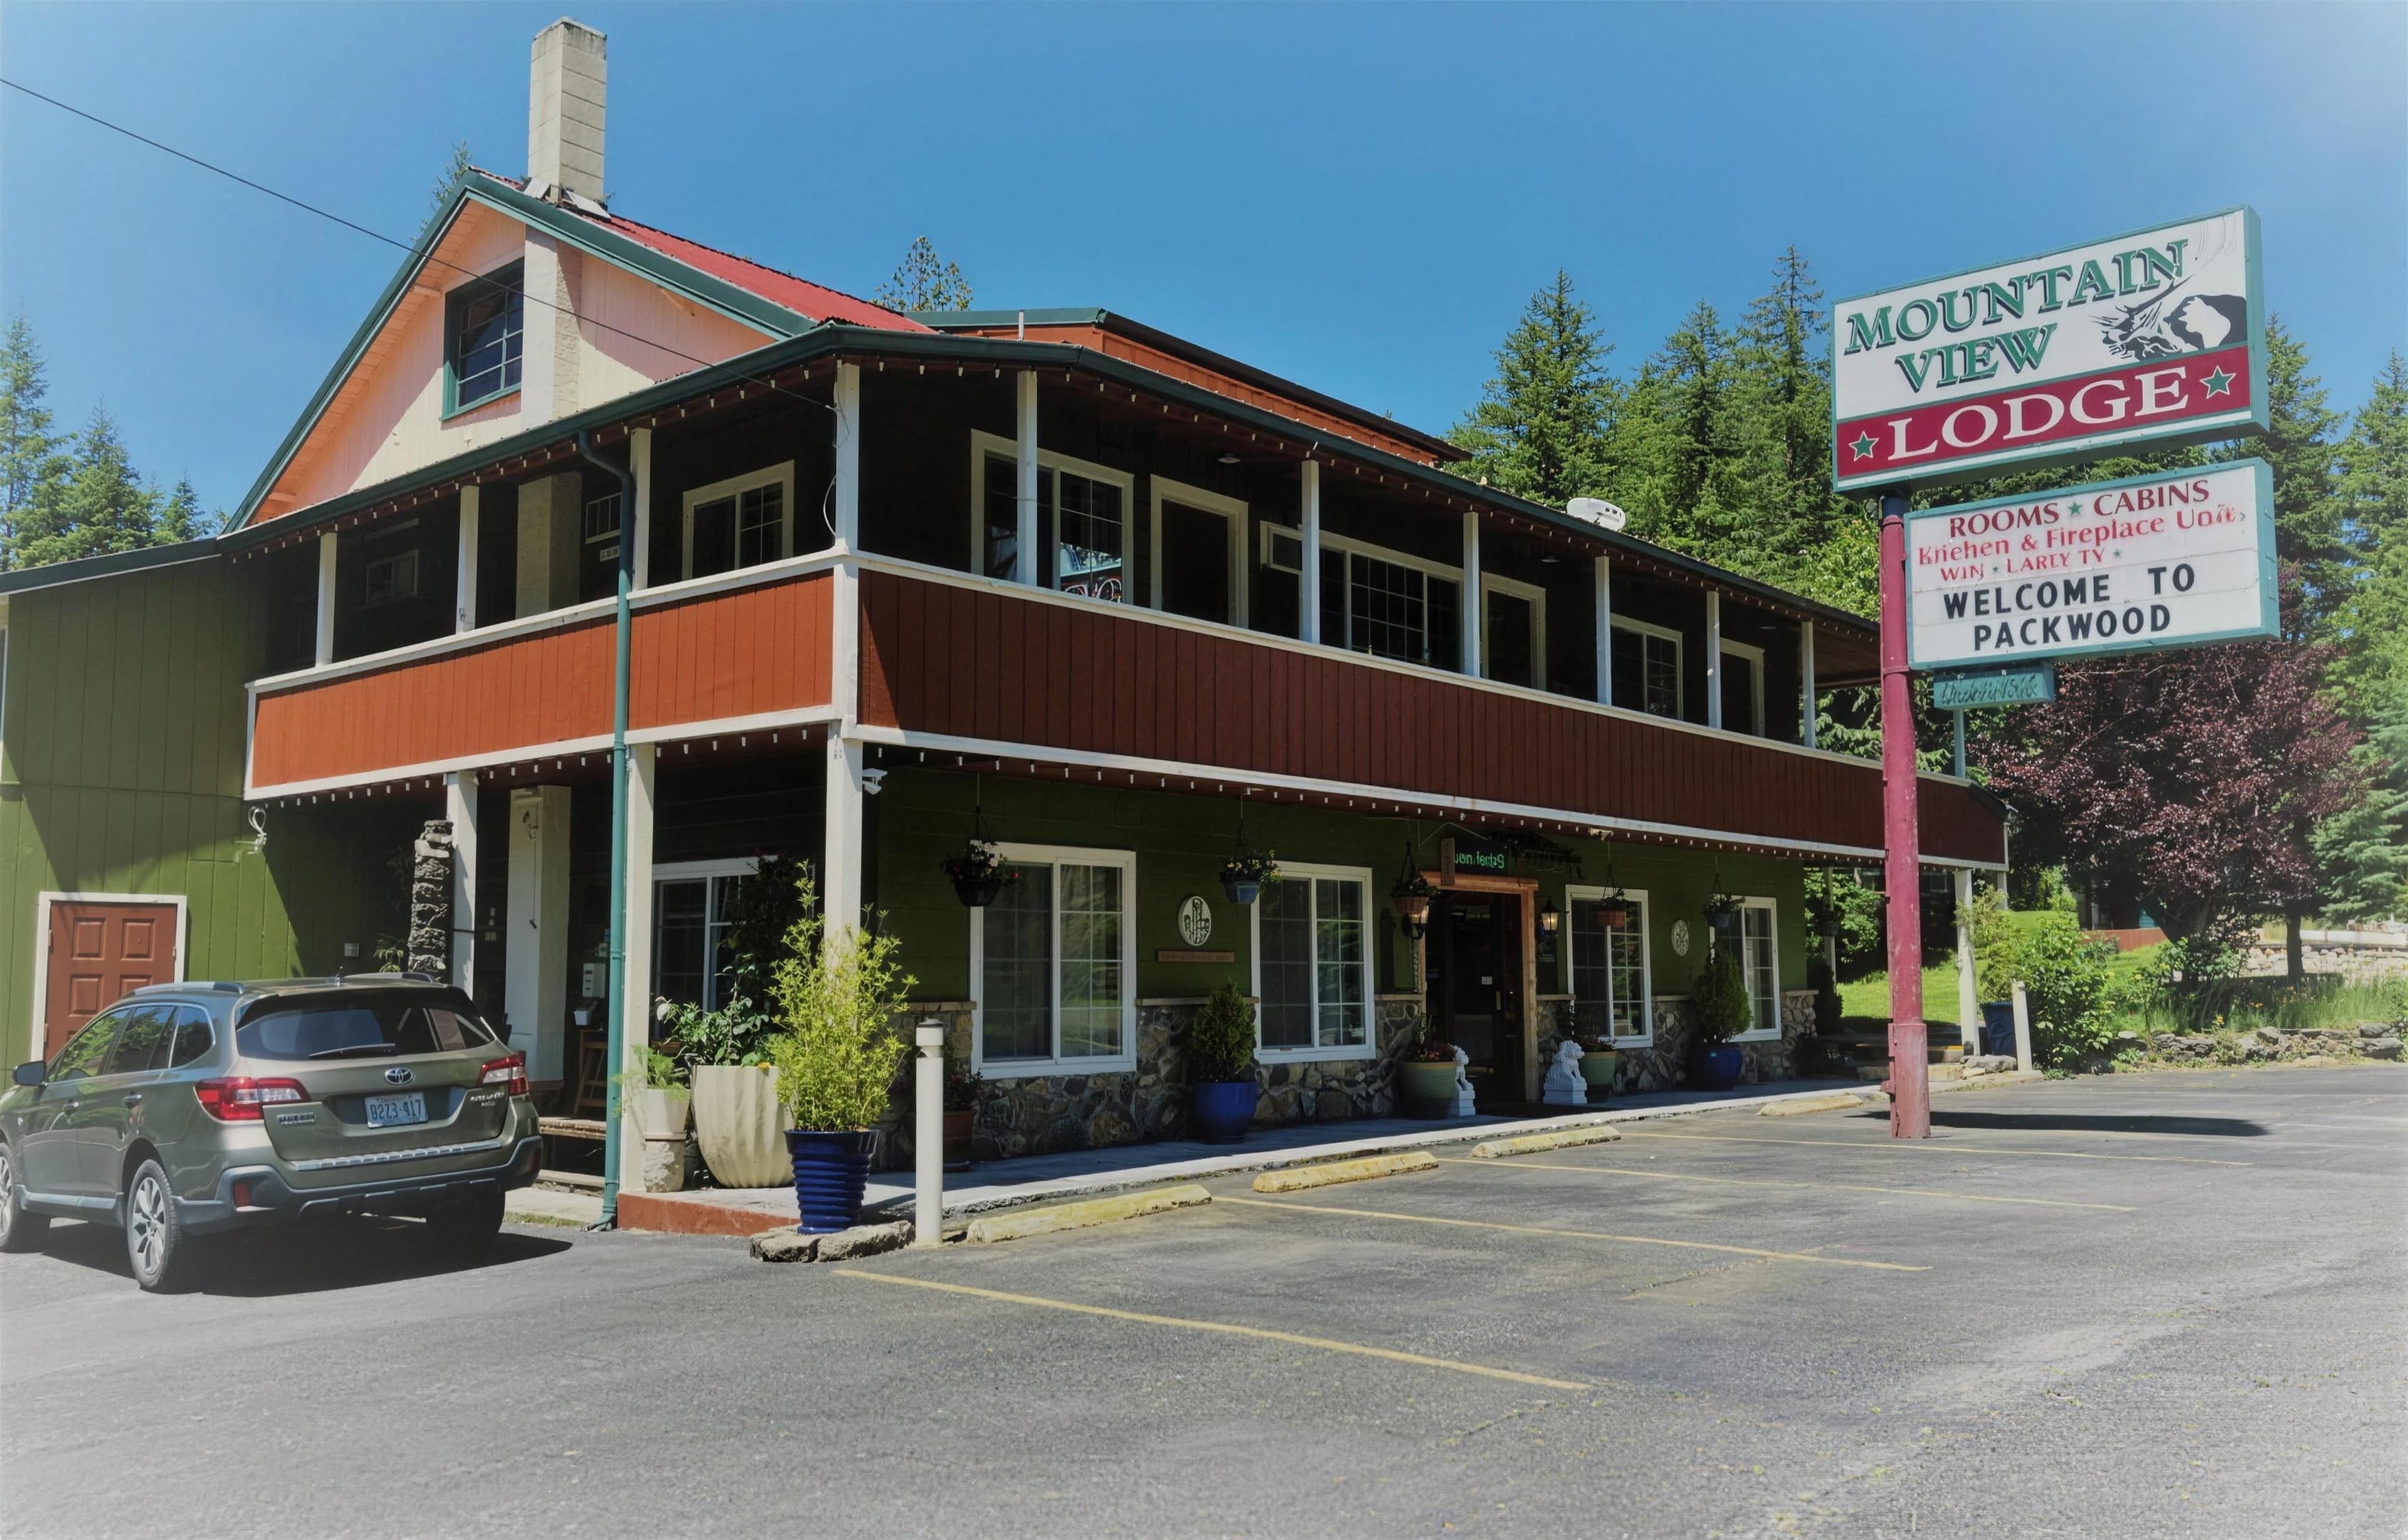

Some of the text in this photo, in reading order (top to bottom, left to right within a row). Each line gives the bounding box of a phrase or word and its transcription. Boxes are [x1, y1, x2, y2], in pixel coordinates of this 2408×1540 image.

[1844, 238, 2188, 355] MOUNTAIN
[1894, 322, 2058, 393] VIEW
[1887, 366, 2189, 460] LODGE
[1950, 480, 2210, 538] ROOMS CABINS
[2020, 534, 2038, 552] &
[2047, 516, 2165, 549] Fireplace
[1943, 563, 2195, 620] WELCOME TO
[1973, 604, 2171, 651] PACKWOOD
